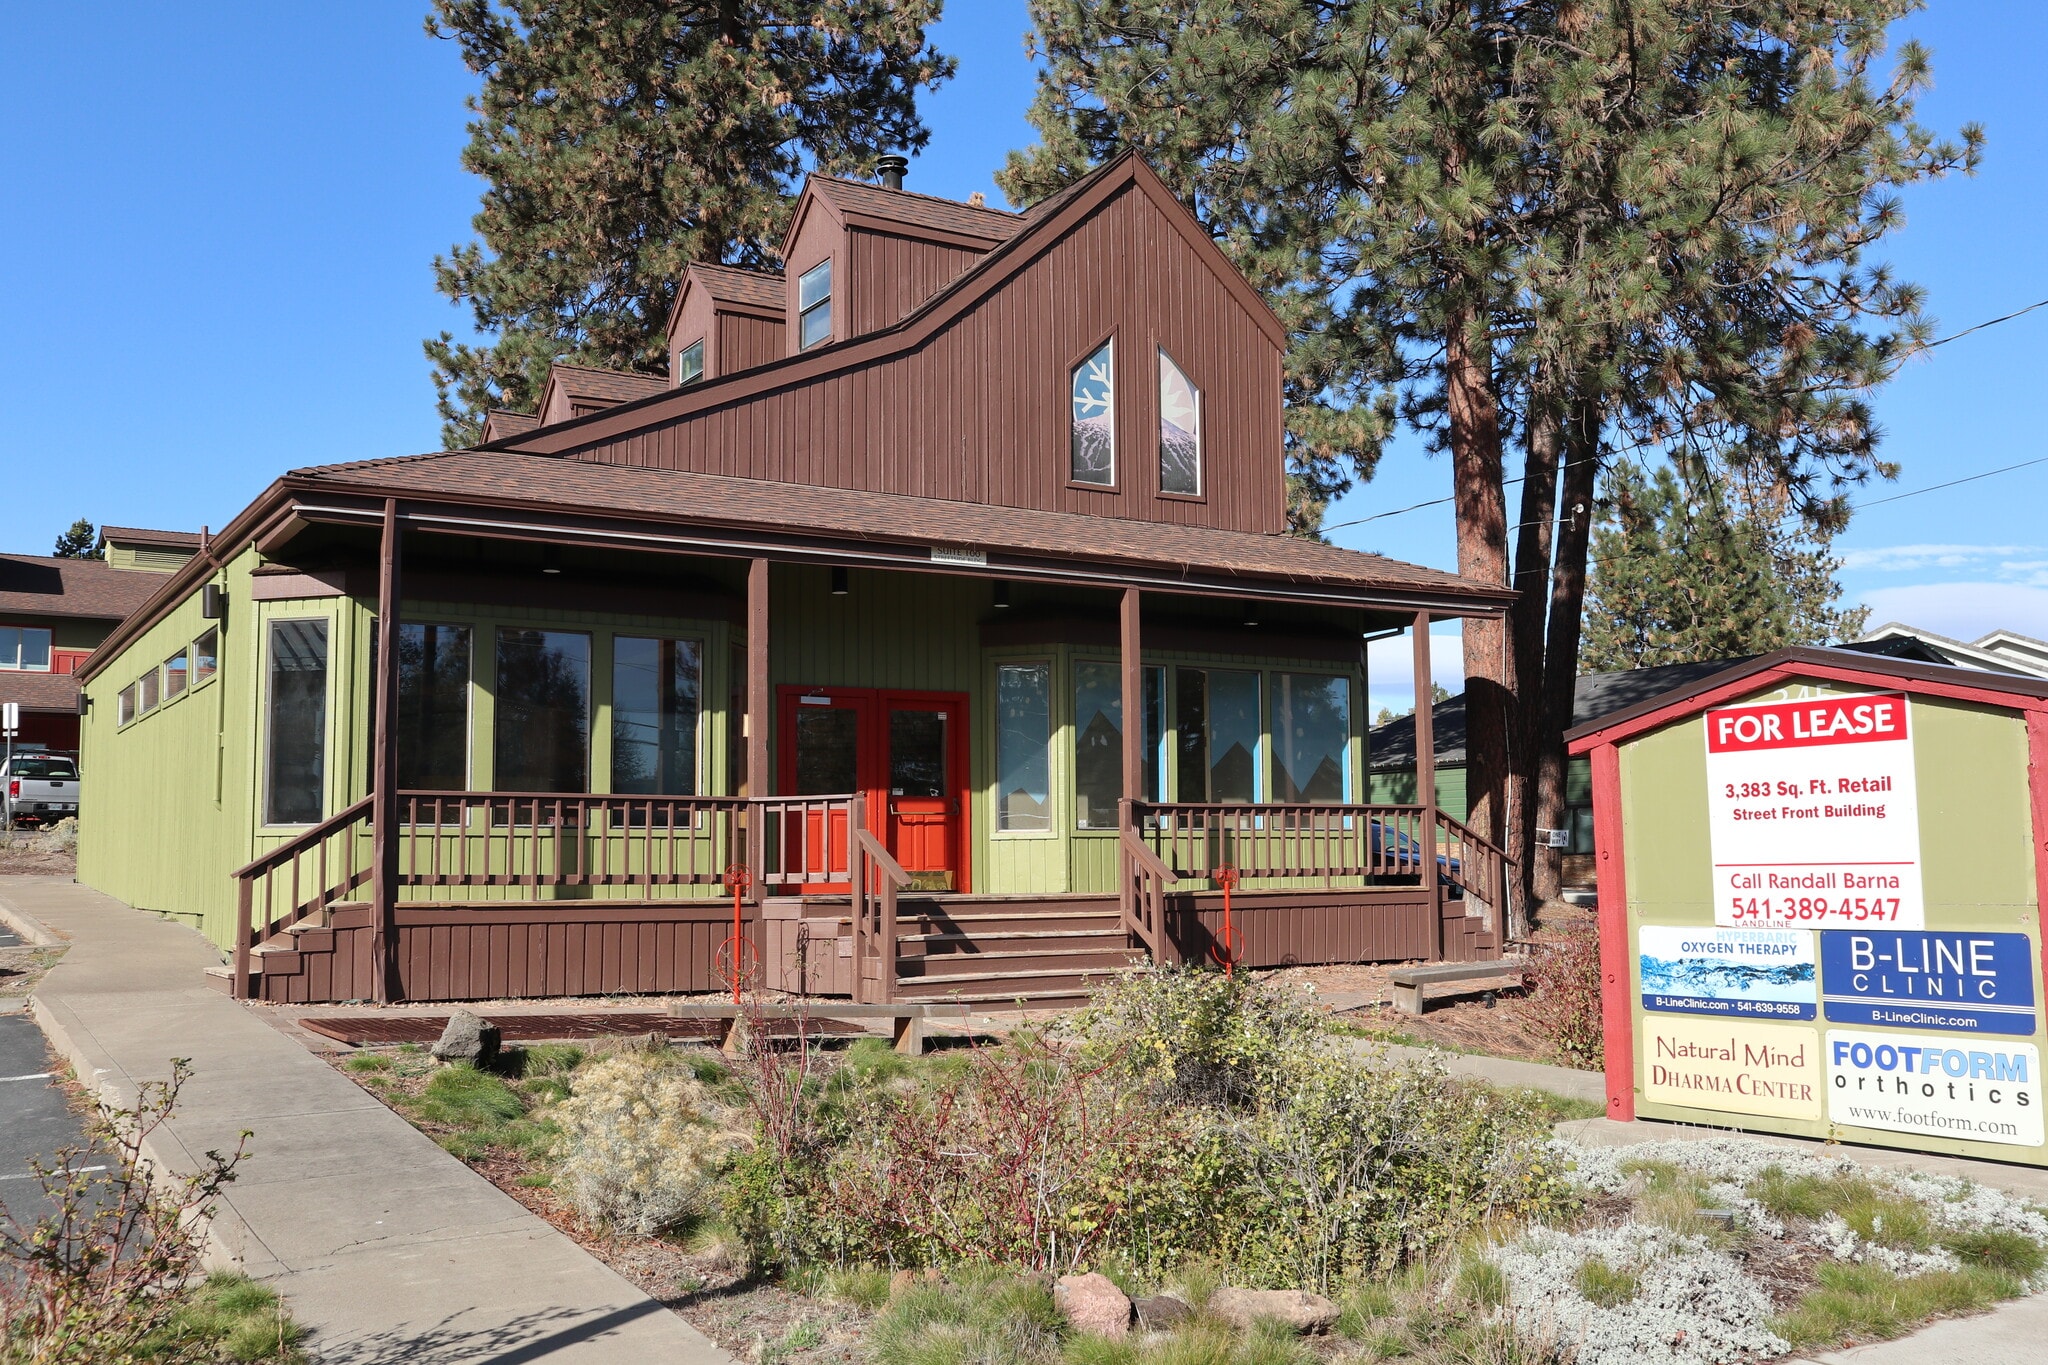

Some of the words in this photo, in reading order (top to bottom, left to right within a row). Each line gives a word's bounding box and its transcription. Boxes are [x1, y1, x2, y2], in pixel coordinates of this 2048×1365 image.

[1718, 714, 1785, 744] FOR
[1792, 703, 1896, 739] LEASE
[1725, 781, 1772, 801] 3,383
[1776, 780, 1803, 799] Sq.
[1809, 779, 1832, 795] Ft.
[1838, 775, 1892, 793] Retail
[1733, 807, 1777, 821] Street
[1781, 805, 1820, 819] Front
[1824, 803, 1887, 819] Building
[1730, 873, 1762, 889] Call
[1769, 872, 1837, 889] Randall
[1844, 872, 1900, 889] Barna
[1731, 897, 1901, 921] 541-389-4547
[1734, 919, 1792, 928] LANDLINE
[1681, 941, 1734, 954] OXYGEN
[1738, 943, 1798, 956] THERAPY
[1716, 930, 1798, 944] HYPERBARIC
[1850, 935, 1997, 977] B-LINE
[1852, 973, 1997, 999] CLINIC
[1655, 996, 1729, 1011] B-LineClinic.com
[1736, 1001, 1801, 1015] 541-639-9558
[1872, 1010, 1978, 1028] B-LineClinic.com
[1656, 1035, 1736, 1062] Natural
[1744, 1043, 1806, 1069] Mind
[1833, 1040, 2029, 1084] FOOTFORM
[1651, 1064, 1733, 1094] DHARMA
[1736, 1073, 1814, 1102] CENTER
[1834, 1074, 2031, 1107] orthotics
[1848, 1106, 2018, 1137] www.footform.com
